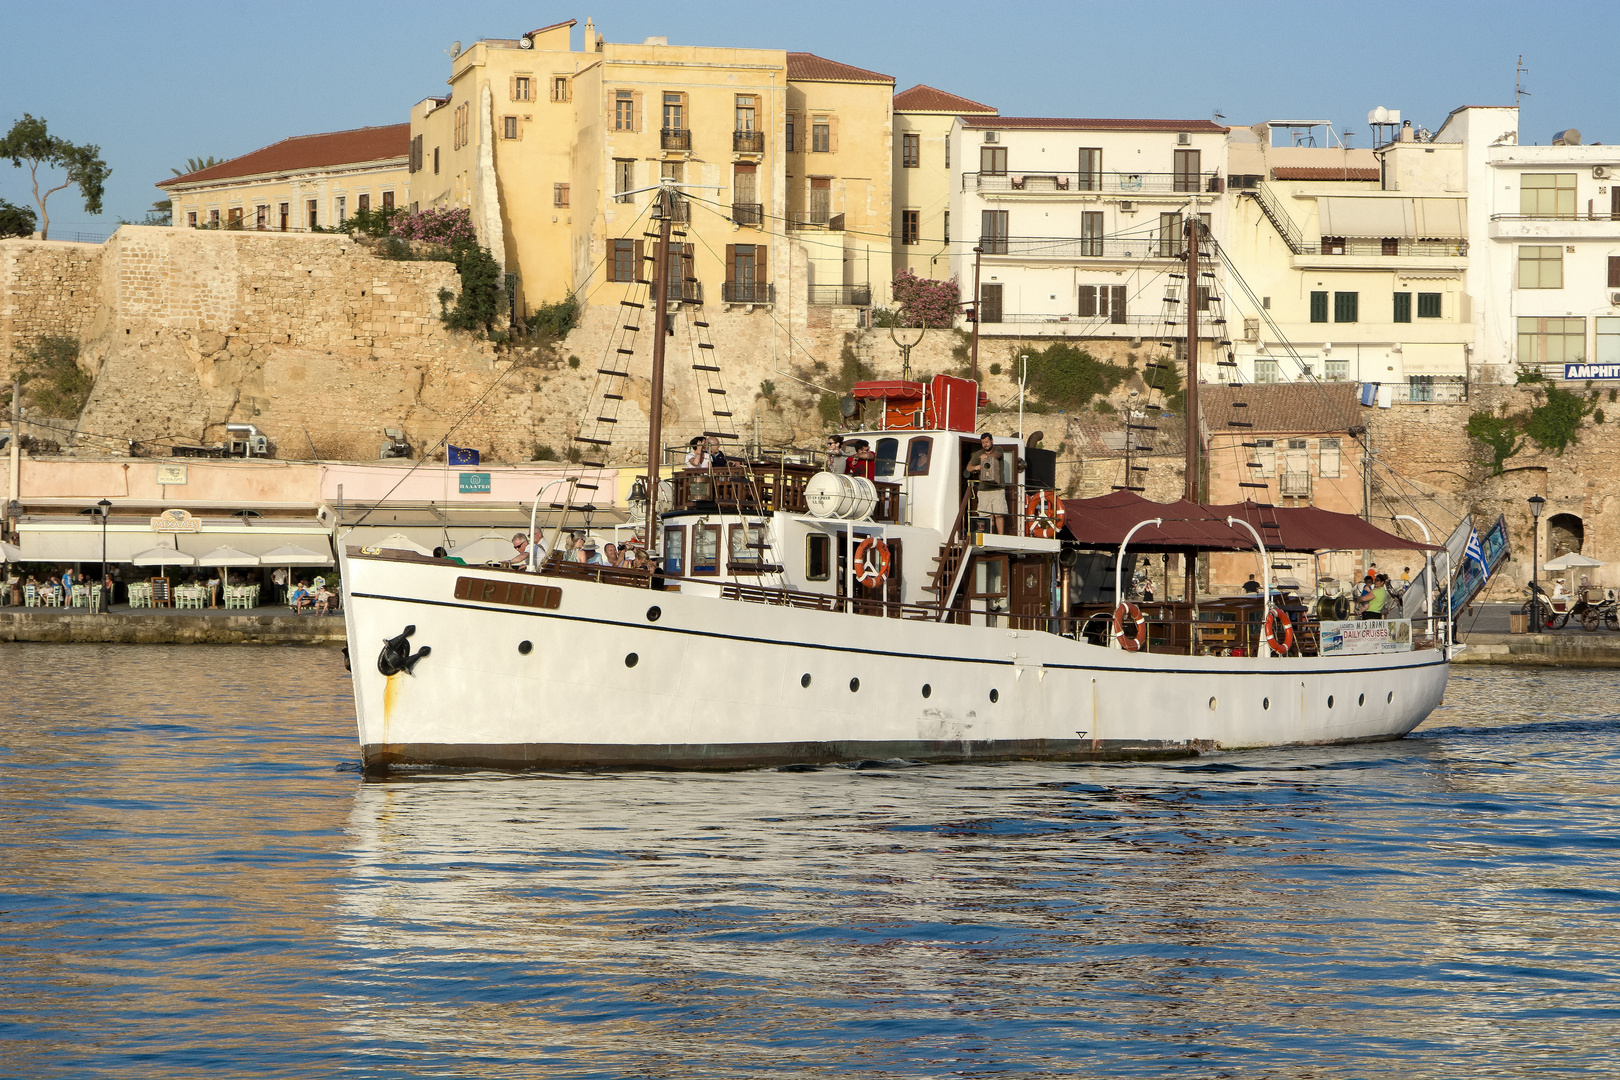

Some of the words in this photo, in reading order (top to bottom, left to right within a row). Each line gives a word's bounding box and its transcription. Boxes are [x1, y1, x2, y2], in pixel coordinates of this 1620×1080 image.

[466, 579, 551, 607] IRINI
[1343, 630, 1361, 639] DAILY
[1361, 629, 1388, 638] CRUISES
